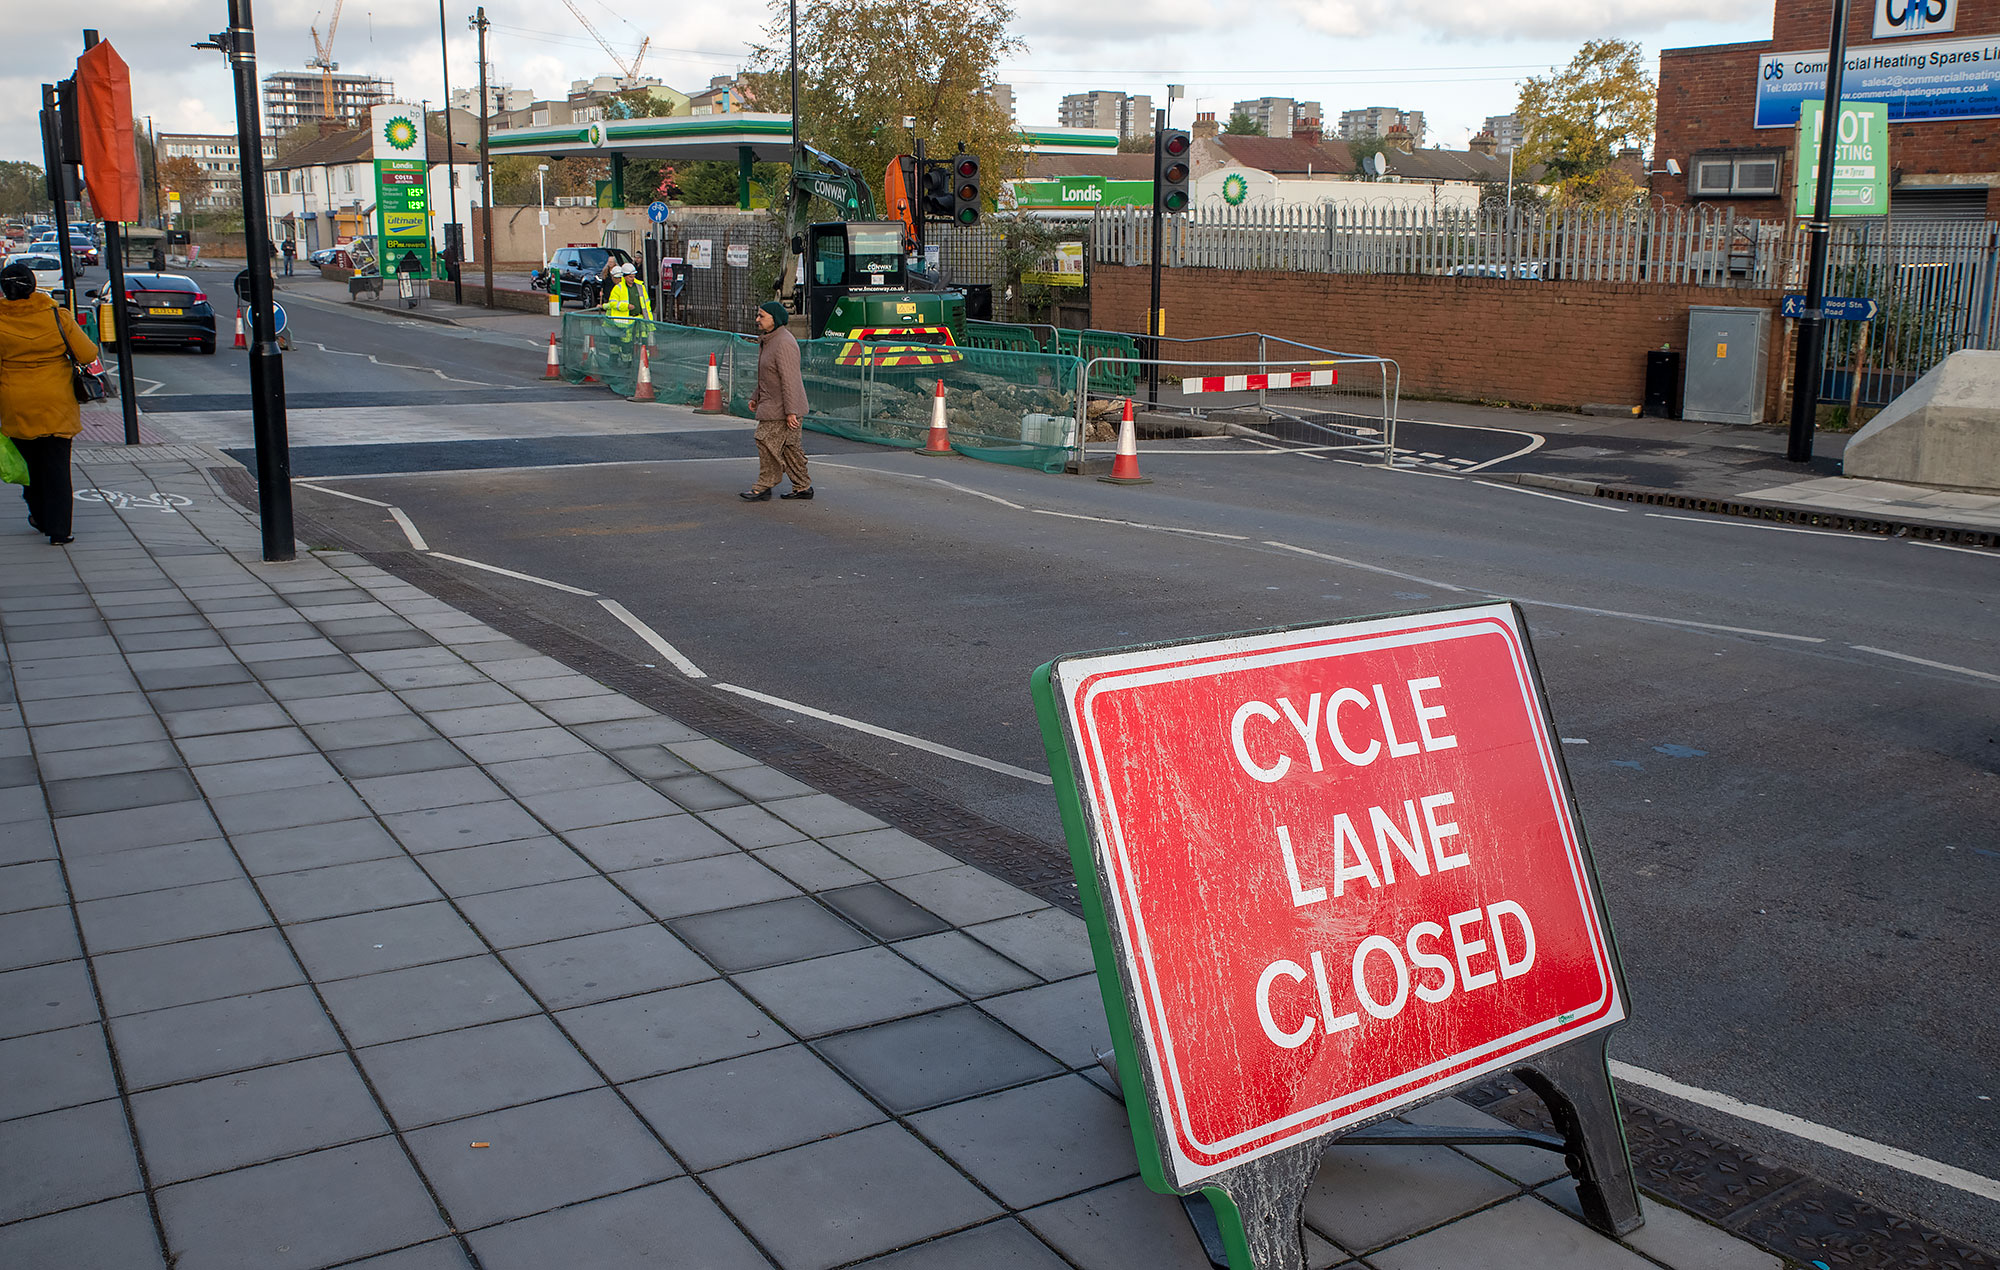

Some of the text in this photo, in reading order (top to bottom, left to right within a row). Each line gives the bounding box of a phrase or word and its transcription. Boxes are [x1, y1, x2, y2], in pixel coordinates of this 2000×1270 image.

[1794, 56, 1871, 74] Comrcial
[1874, 53, 1927, 69] Heating
[1929, 51, 1980, 67] Spares
[1766, 84, 1781, 93] Tel:
[1782, 82, 1802, 92] 0203
[1804, 82, 1818, 91] 771
[410, 110, 420, 119] bp
[1813, 144, 1873, 161] TSTING
[815, 180, 847, 202] CONWAY
[1062, 184, 1102, 202] Londis
[387, 217, 423, 225] ultimate
[1824, 308, 1843, 316] Road
[1231, 676, 1458, 782] CYCLE
[1276, 791, 1471, 907] LANE
[1256, 900, 1536, 1049] CLOSED
